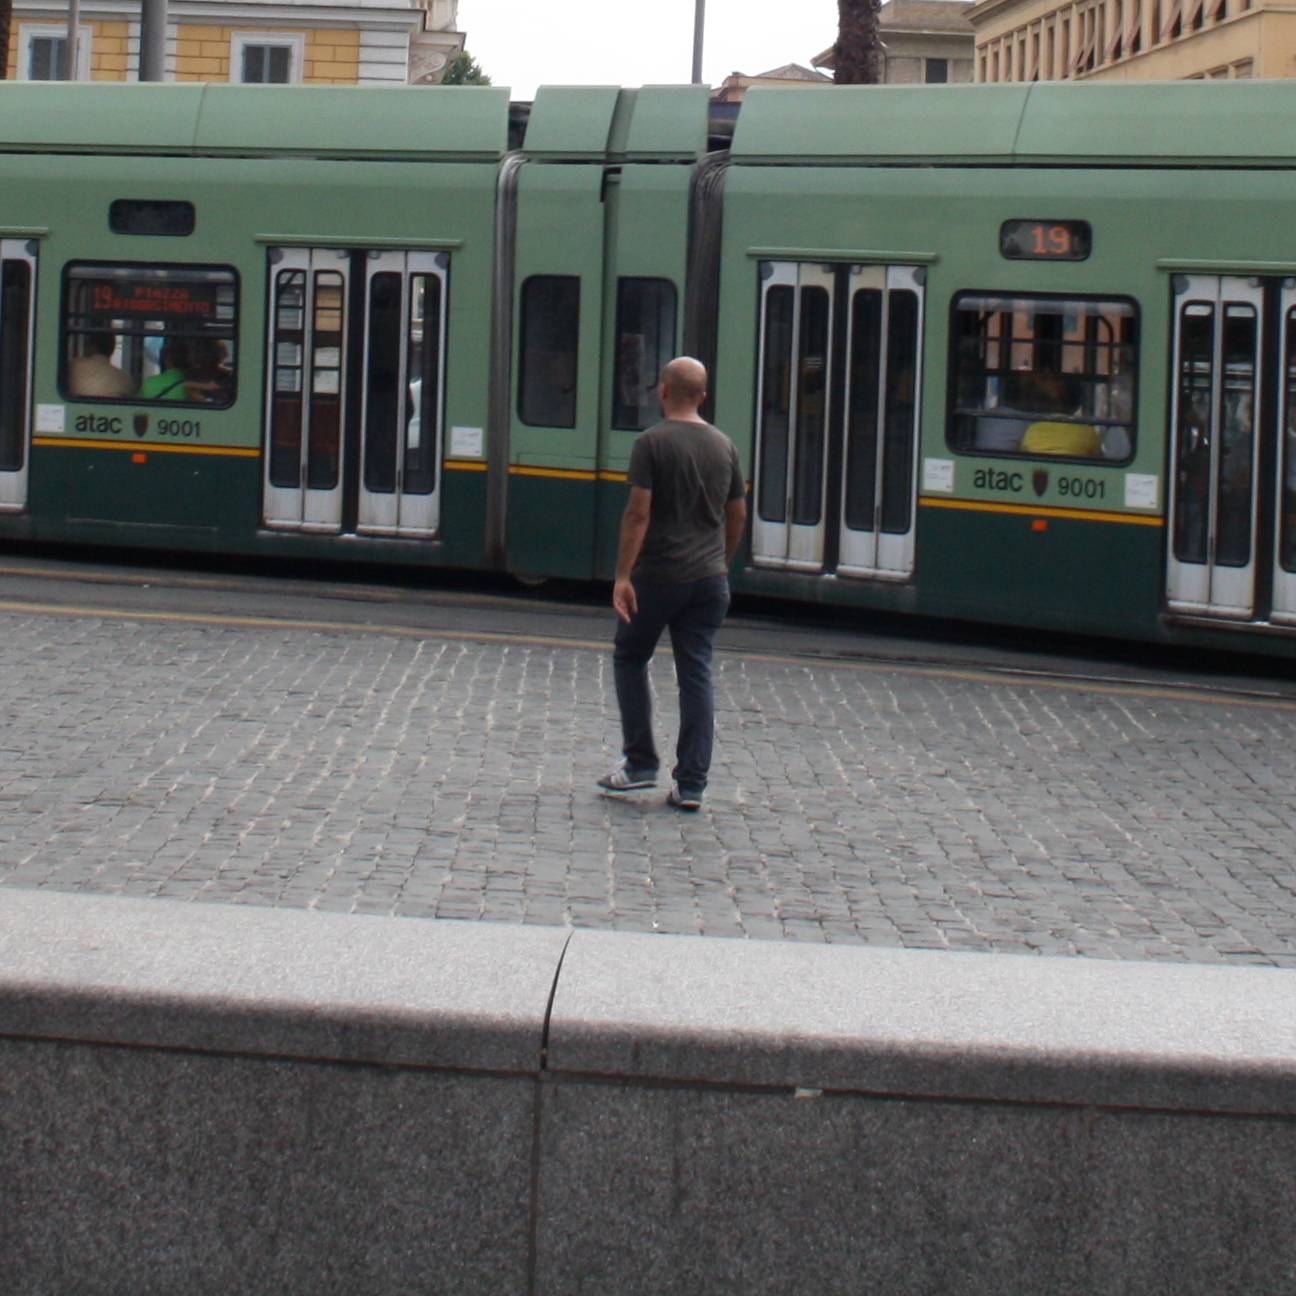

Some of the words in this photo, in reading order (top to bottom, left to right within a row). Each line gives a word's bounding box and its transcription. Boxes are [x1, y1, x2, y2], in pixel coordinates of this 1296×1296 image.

[1031, 225, 1070, 254] 19
[93, 286, 112, 309] 19
[134, 287, 189, 300] PIAZZA
[75, 413, 122, 434] atac
[157, 419, 202, 438] 9001
[973, 467, 1023, 493] atac
[1057, 477, 1105, 499] 9001
